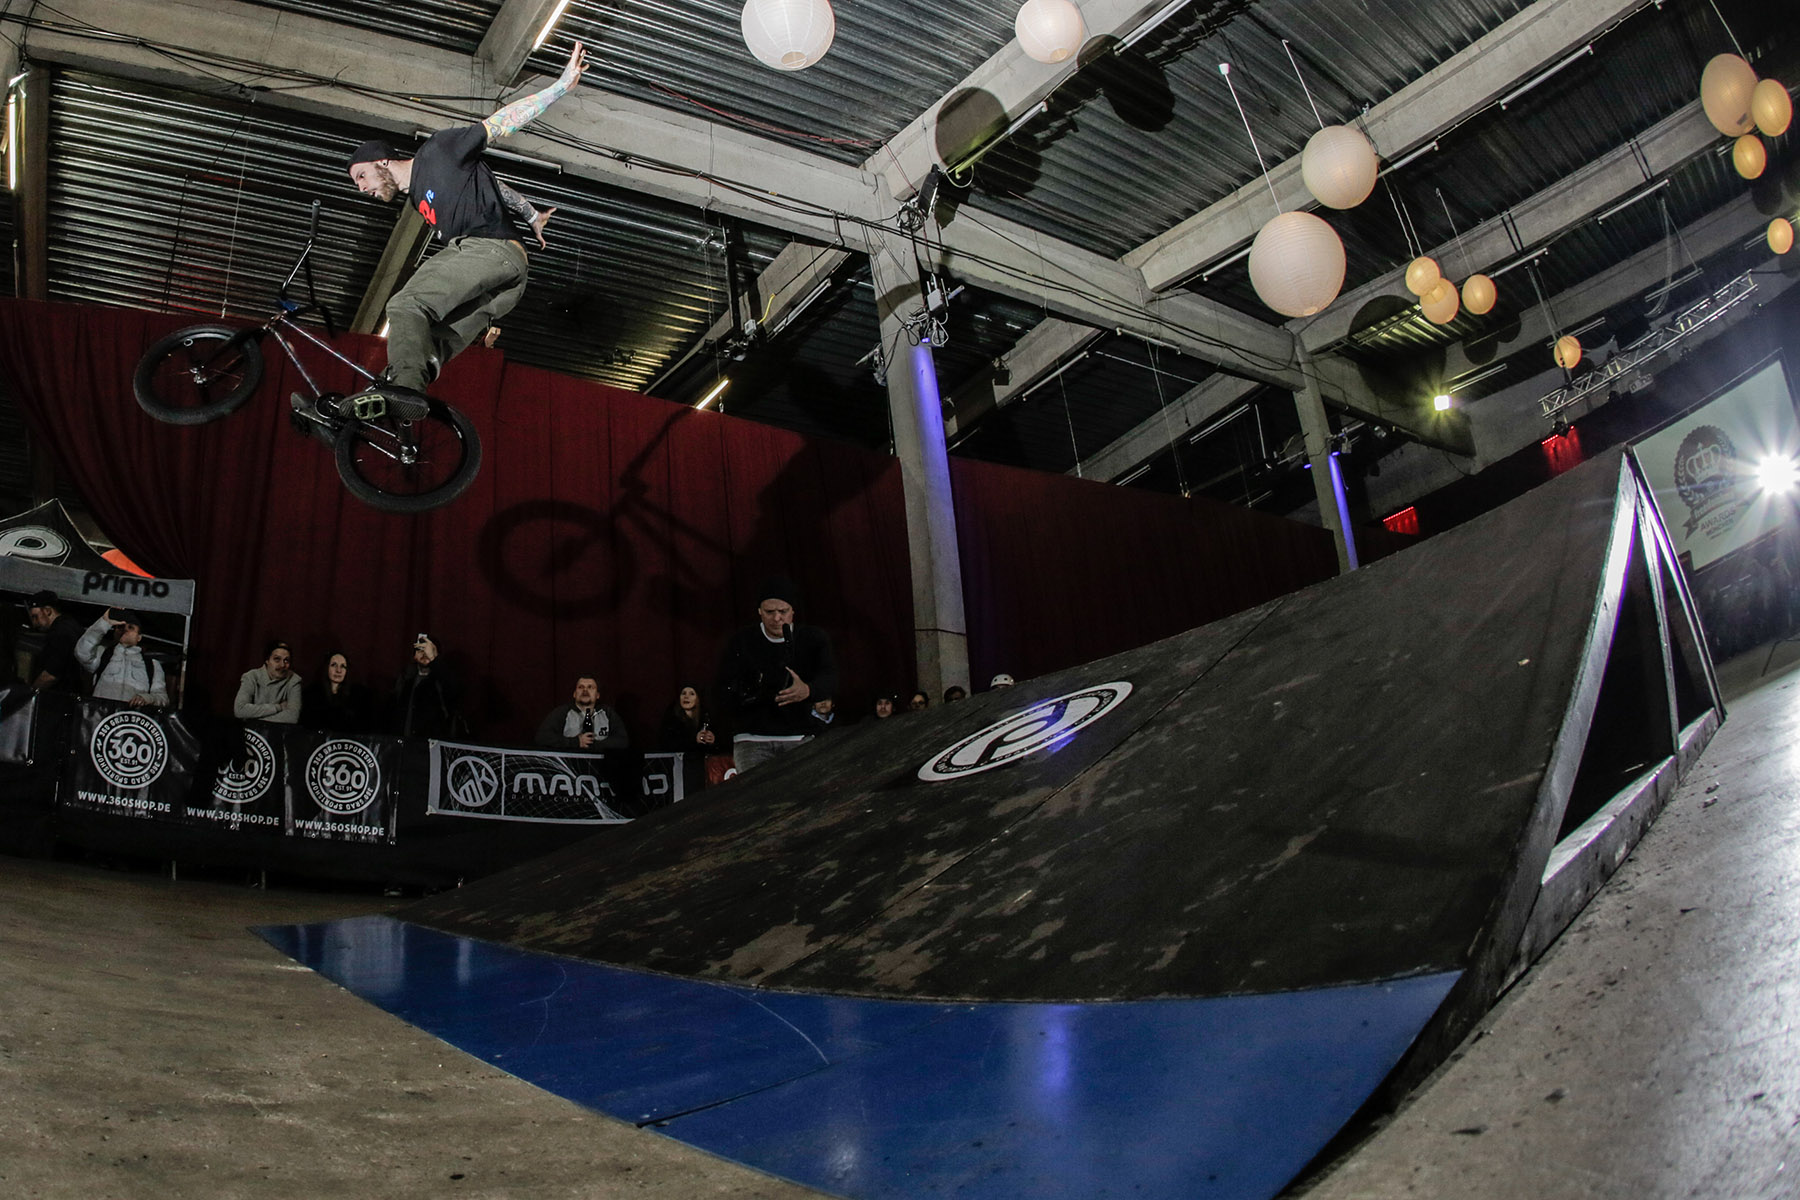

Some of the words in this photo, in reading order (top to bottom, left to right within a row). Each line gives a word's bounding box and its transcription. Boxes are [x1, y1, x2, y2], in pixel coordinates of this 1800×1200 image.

[1701, 510, 1736, 531] AWARDS
[82, 572, 170, 598] primo
[110, 715, 129, 727] GRAD
[131, 715, 163, 746] SPORTSHOP
[108, 736, 152, 764] 360
[244, 733, 271, 760] ORTSHOP
[322, 764, 366, 789] 360
[78, 790, 171, 812] WWW.360SHOP.DE
[187, 806, 280, 826] WWW.360SHOP.DE
[295, 819, 385, 836] WWW.360SHOP.DE
